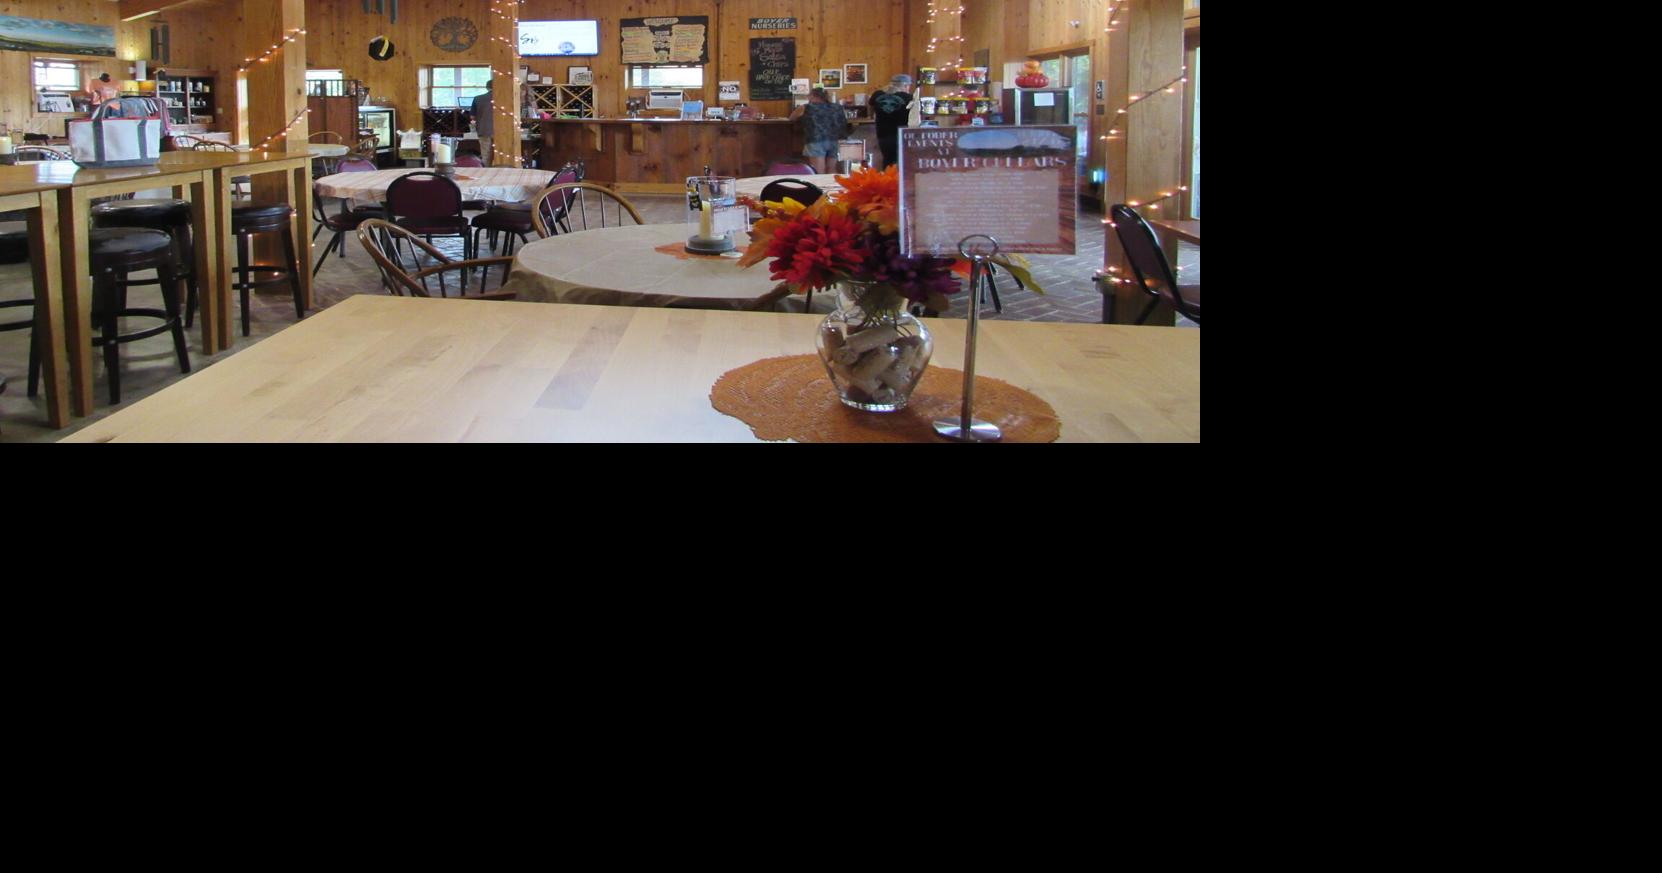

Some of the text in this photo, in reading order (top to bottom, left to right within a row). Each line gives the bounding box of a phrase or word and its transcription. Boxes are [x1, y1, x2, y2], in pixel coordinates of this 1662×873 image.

[904, 131, 958, 139] OCTOBER
[907, 139, 954, 147] EVENTS
[937, 147, 951, 155] AT
[918, 156, 1067, 169] BOYER CELLARS
